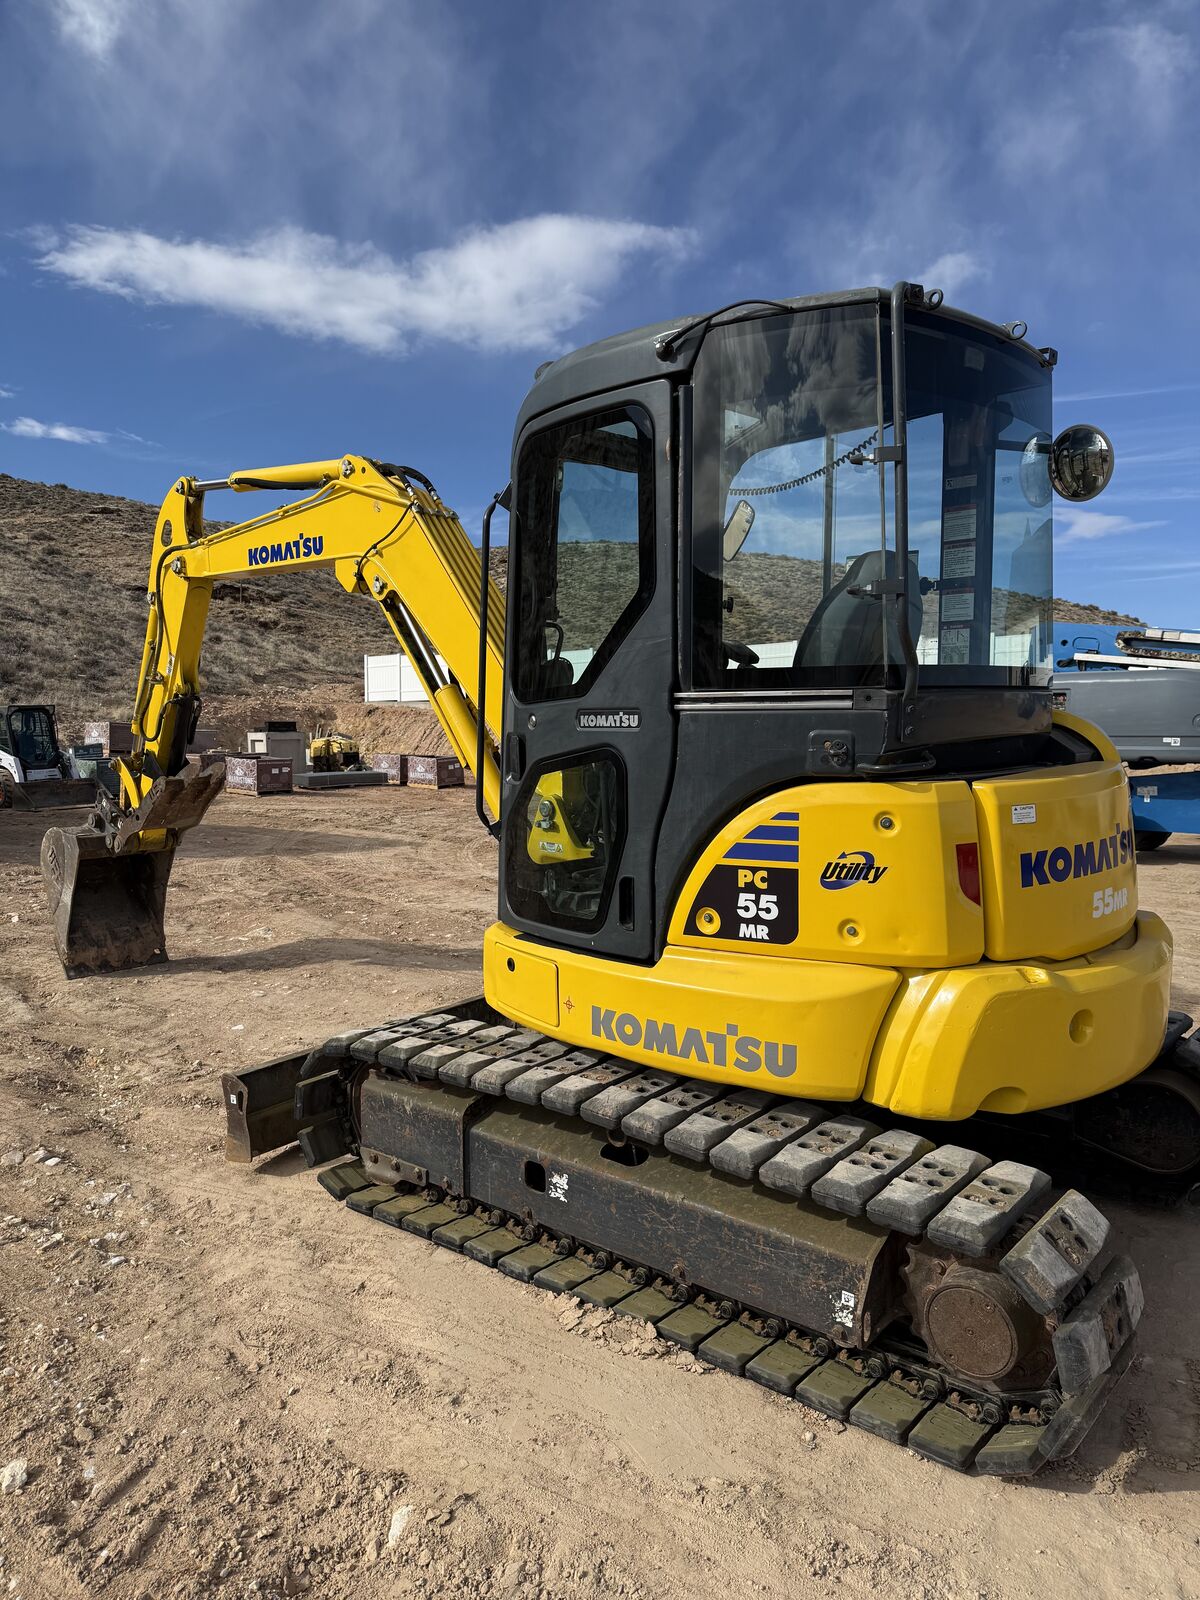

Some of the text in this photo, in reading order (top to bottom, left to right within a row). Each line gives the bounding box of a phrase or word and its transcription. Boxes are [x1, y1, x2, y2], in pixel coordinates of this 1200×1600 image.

[248, 533, 323, 566] KOMATSU
[580, 712, 638, 727] KOMATSU
[1020, 823, 1133, 888] KOMATSU
[738, 869, 767, 889] PC
[820, 862, 888, 884] Utility
[737, 893, 779, 920] 55
[739, 923, 769, 940] MR
[592, 1005, 797, 1078] KOMATSU
